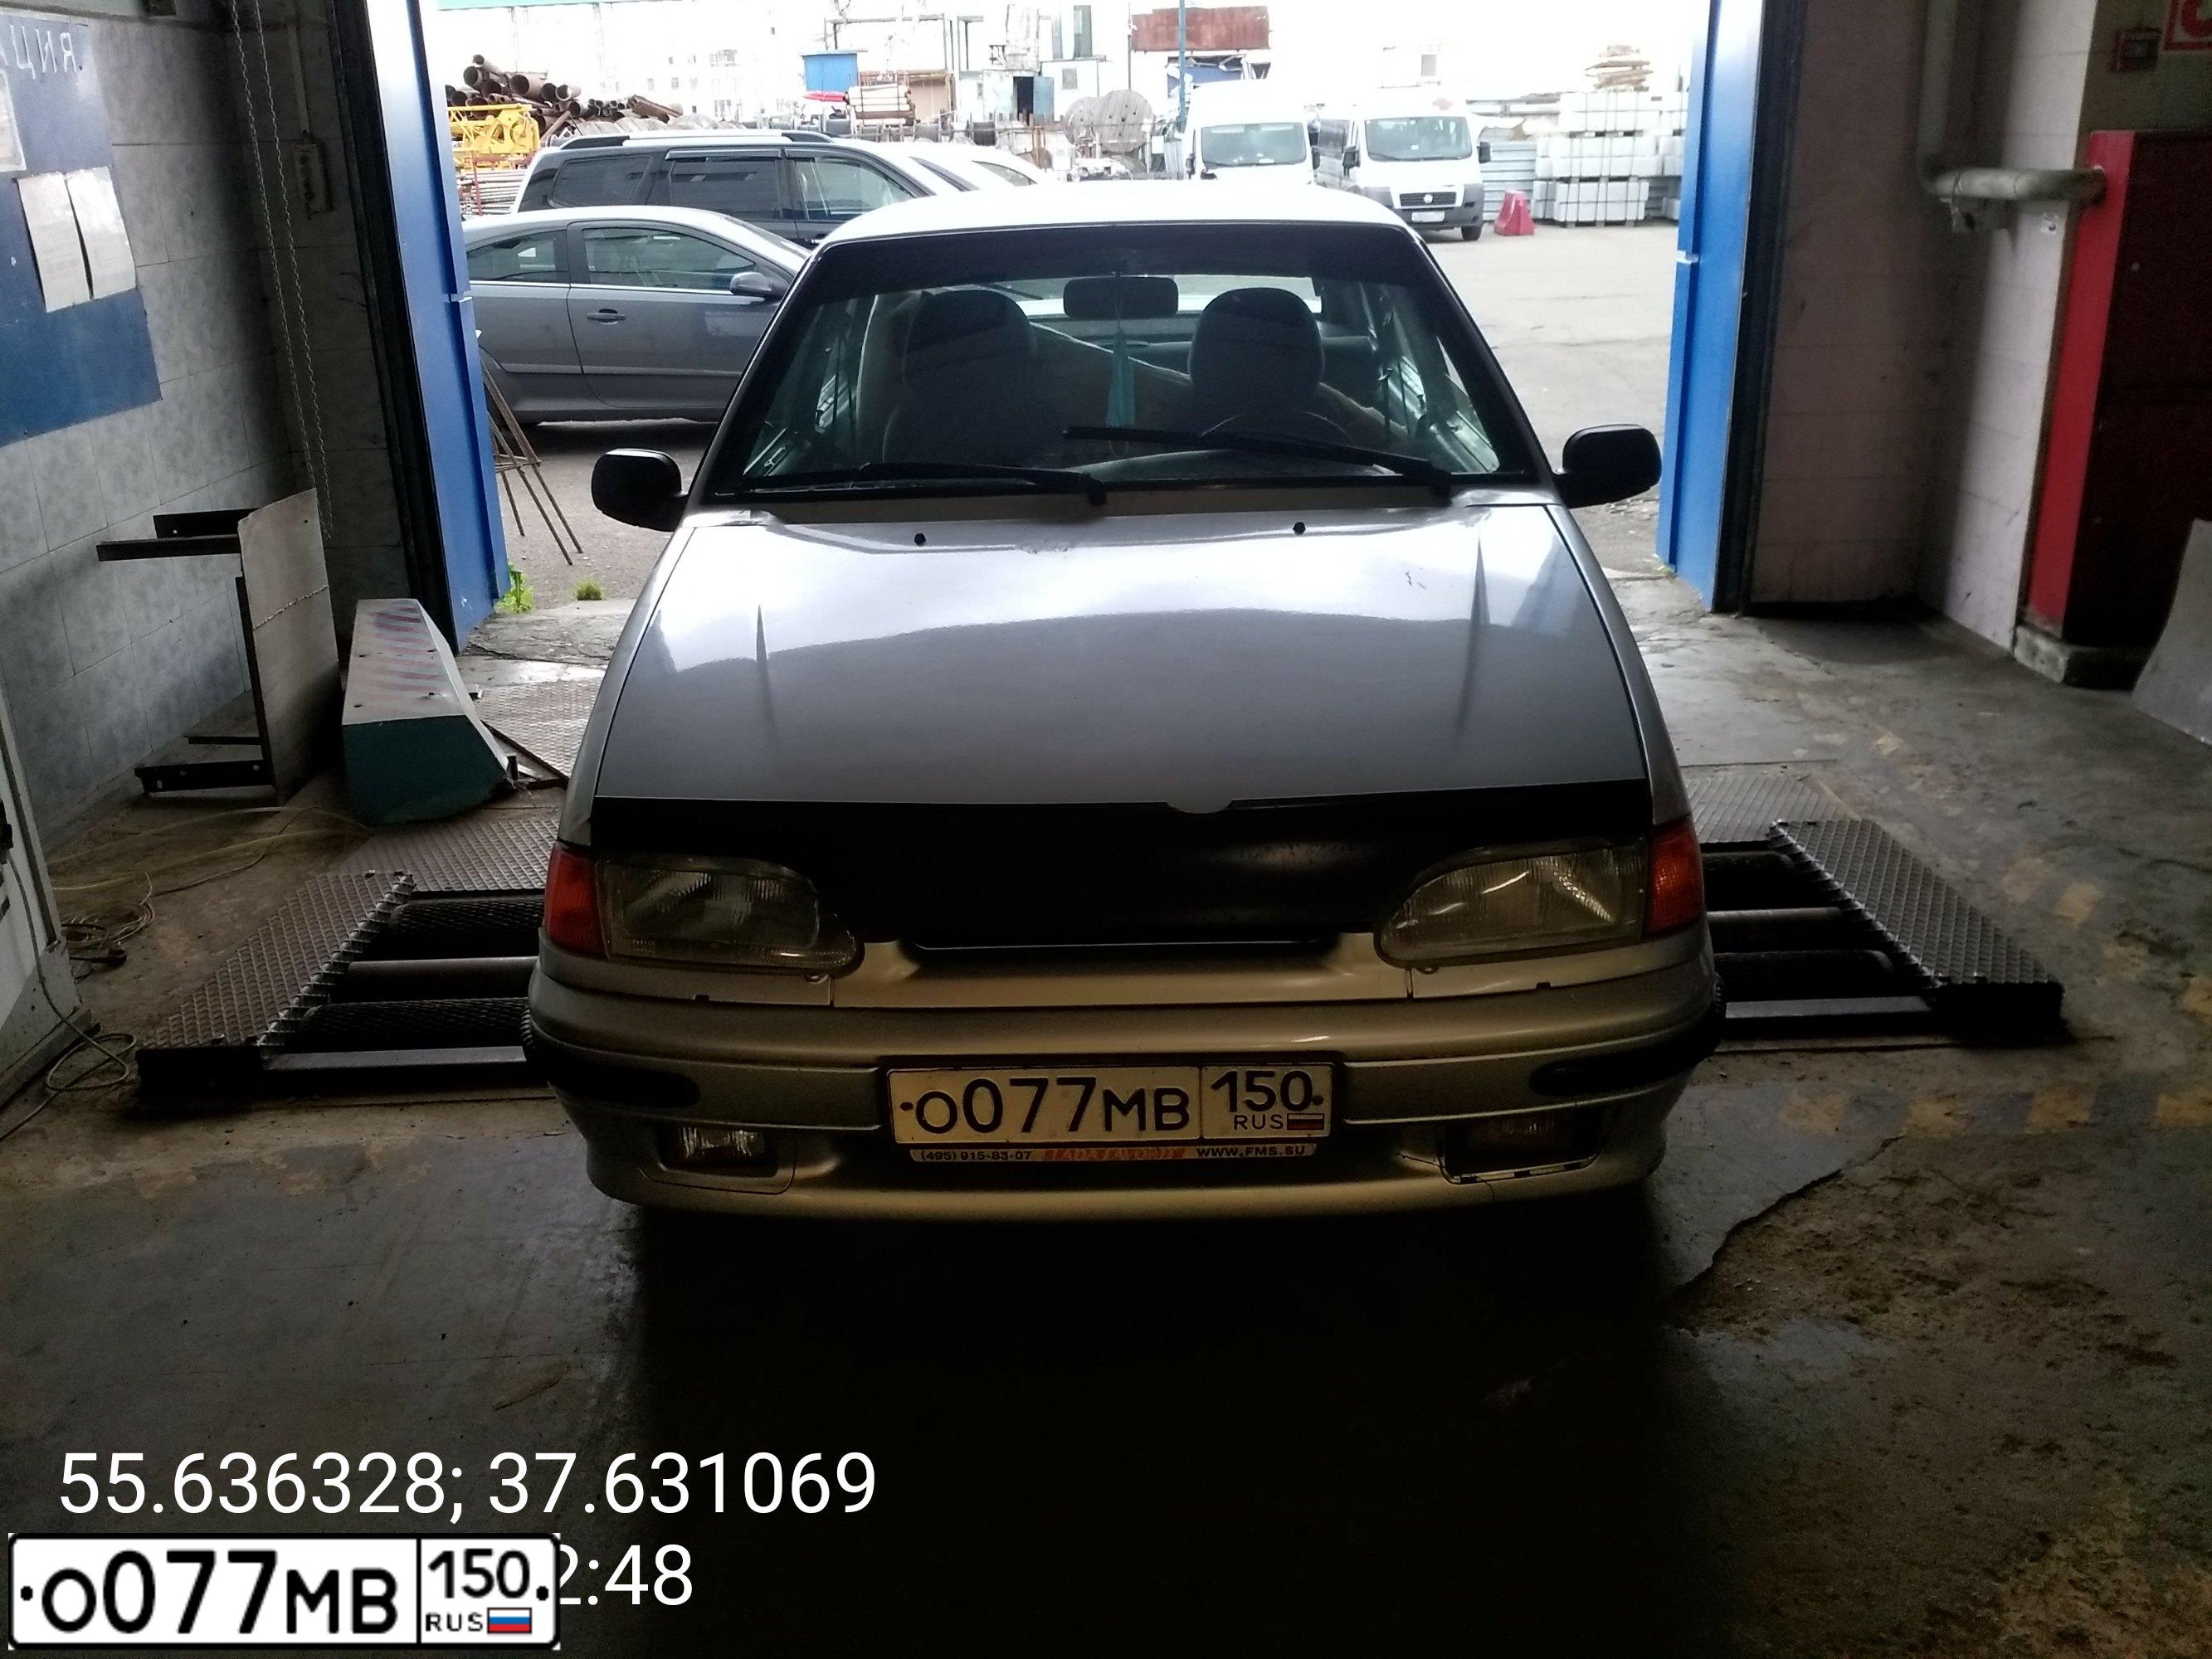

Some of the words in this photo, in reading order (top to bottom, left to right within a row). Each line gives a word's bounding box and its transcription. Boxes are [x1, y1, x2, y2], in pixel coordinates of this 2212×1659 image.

[0, 24, 77, 80] ЦИЯ
[1210, 1069, 1313, 1113] 150
[1233, 1114, 1284, 1131] RUS
